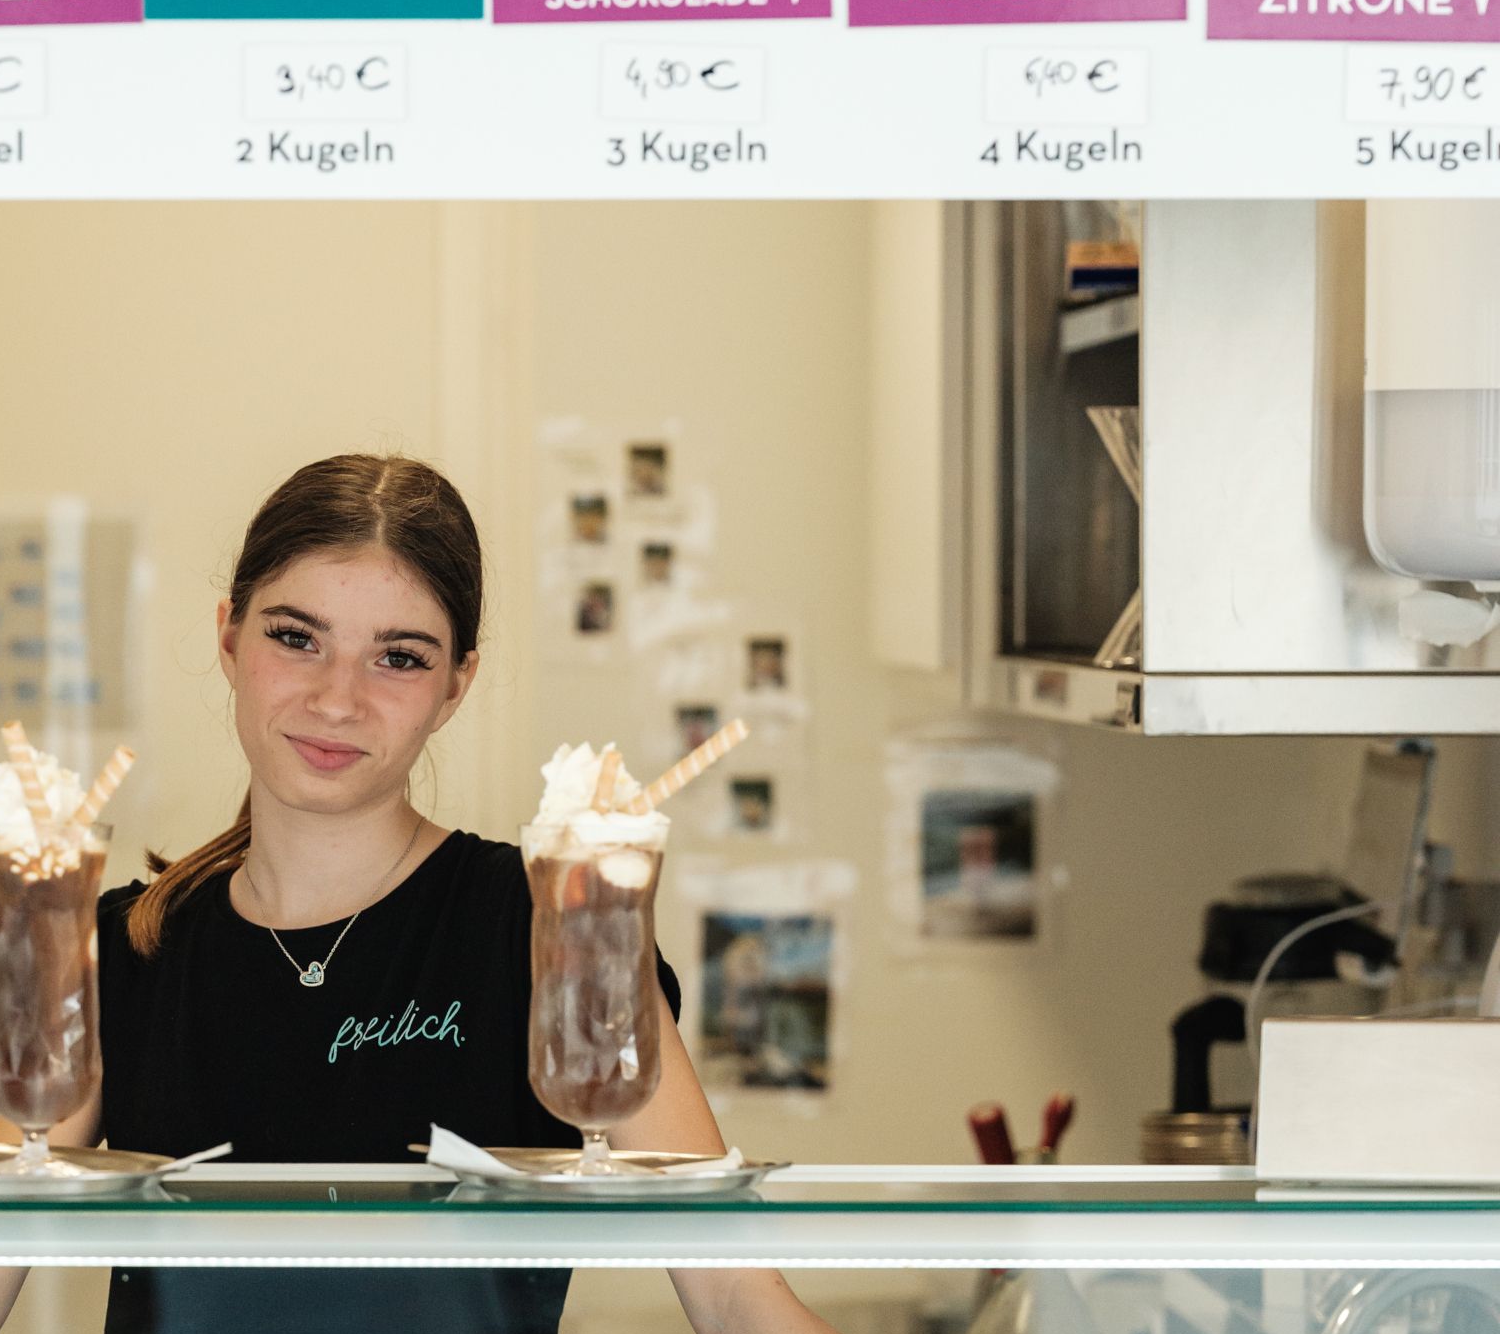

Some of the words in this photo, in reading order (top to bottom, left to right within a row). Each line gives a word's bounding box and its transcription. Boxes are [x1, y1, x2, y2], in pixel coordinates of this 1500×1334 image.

[237, 139, 253, 163] 2
[269, 130, 393, 172] Kugeln
[607, 138, 626, 166] 3
[642, 129, 766, 172] Kugeln
[980, 141, 999, 164] 4
[1016, 128, 1141, 171] Kugeln
[1357, 137, 1375, 166] 5
[1391, 128, 1500, 171] Kugel
